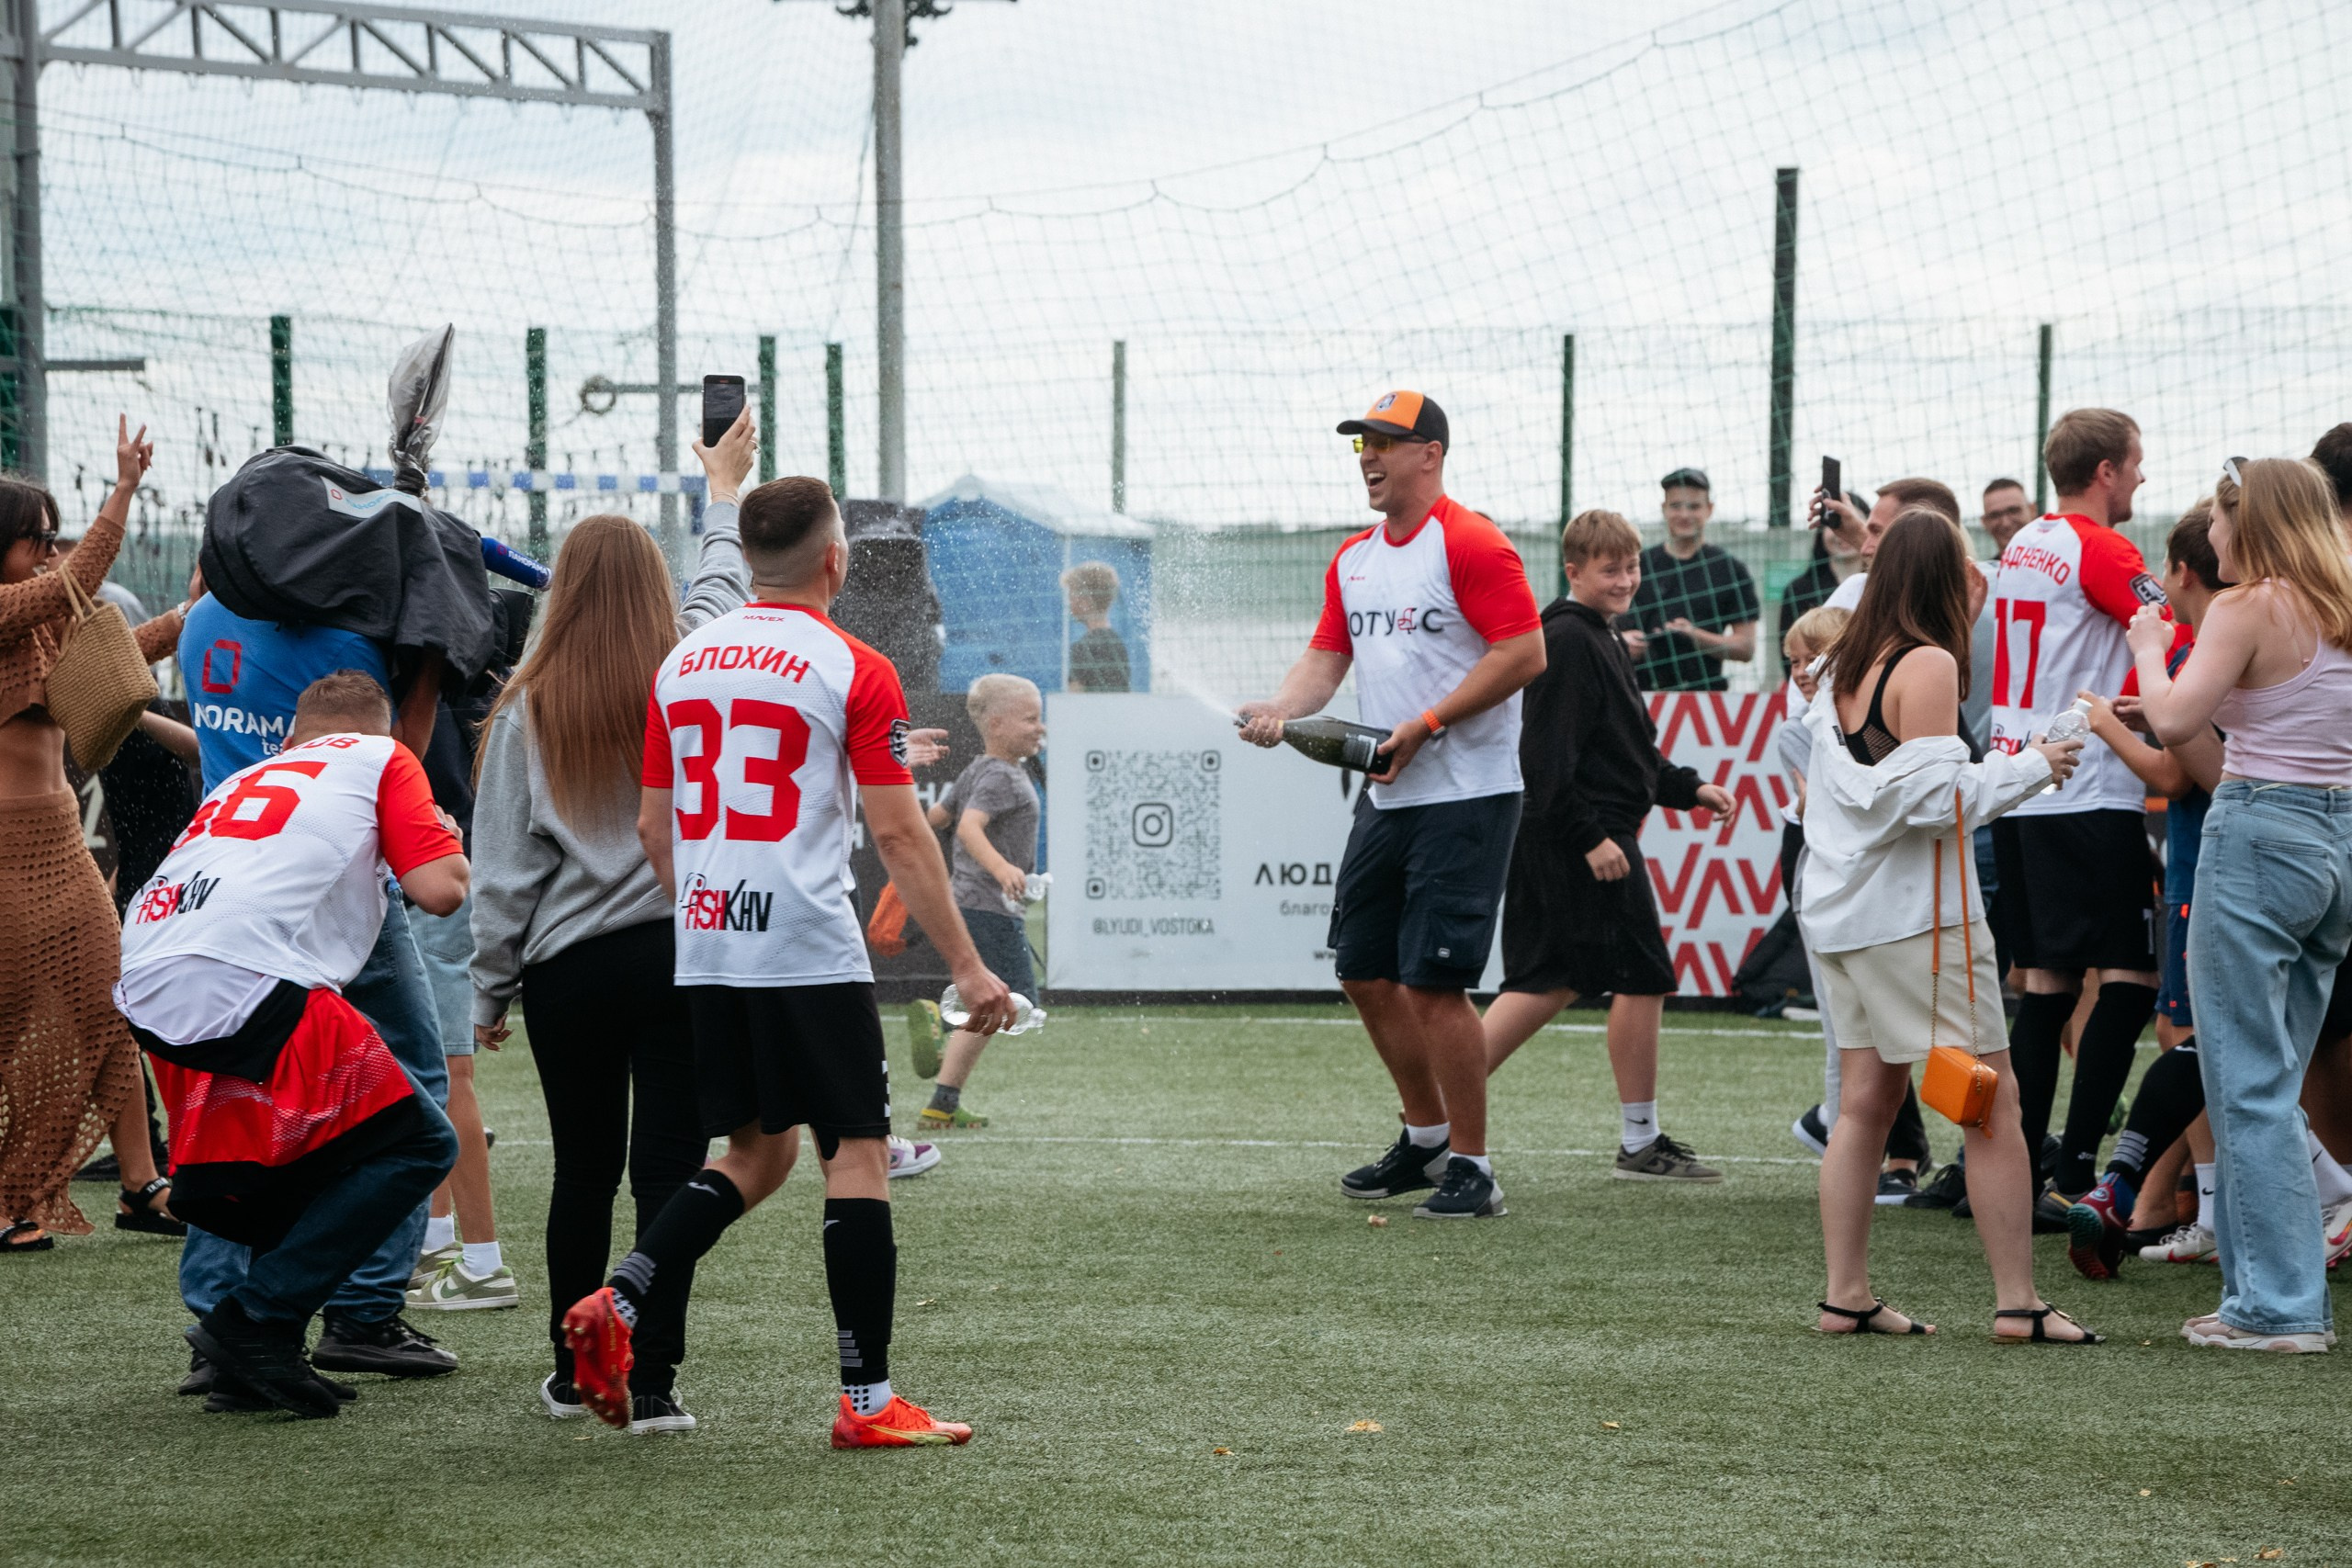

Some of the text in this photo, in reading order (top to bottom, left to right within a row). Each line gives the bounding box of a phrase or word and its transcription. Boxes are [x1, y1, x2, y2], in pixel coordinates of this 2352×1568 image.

[678, 646, 810, 683] БЛОХИН
[1992, 598, 2046, 709] 17
[666, 698, 811, 842] 33
[1254, 863, 1333, 886] ЛЮД
